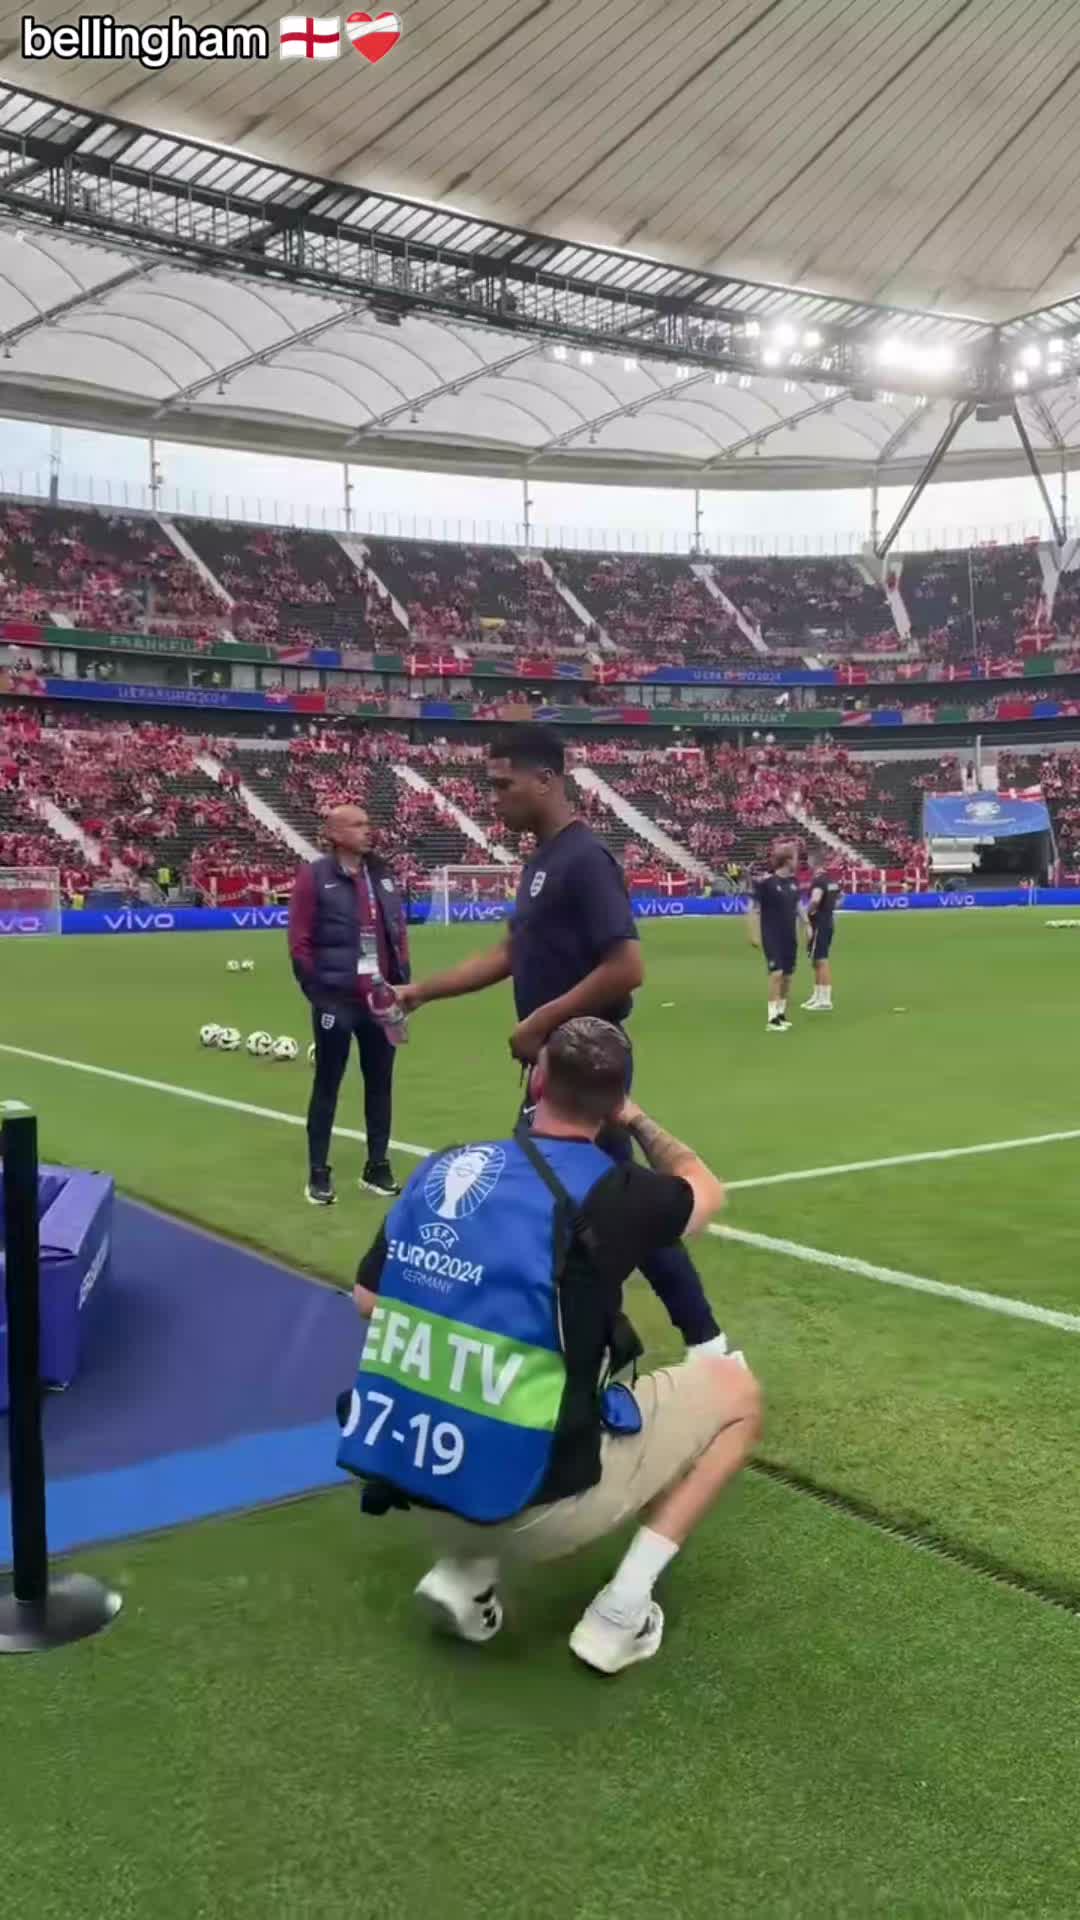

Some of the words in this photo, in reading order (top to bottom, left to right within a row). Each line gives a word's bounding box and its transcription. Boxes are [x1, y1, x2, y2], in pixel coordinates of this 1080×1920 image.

[637, 900, 684, 915] vivo
[872, 895, 909, 909] vivo
[103, 910, 174, 930] vivo
[420, 1226, 456, 1249] UEFA
[387, 1239, 484, 1287] EURO2024
[447, 1332, 525, 1405] TV
